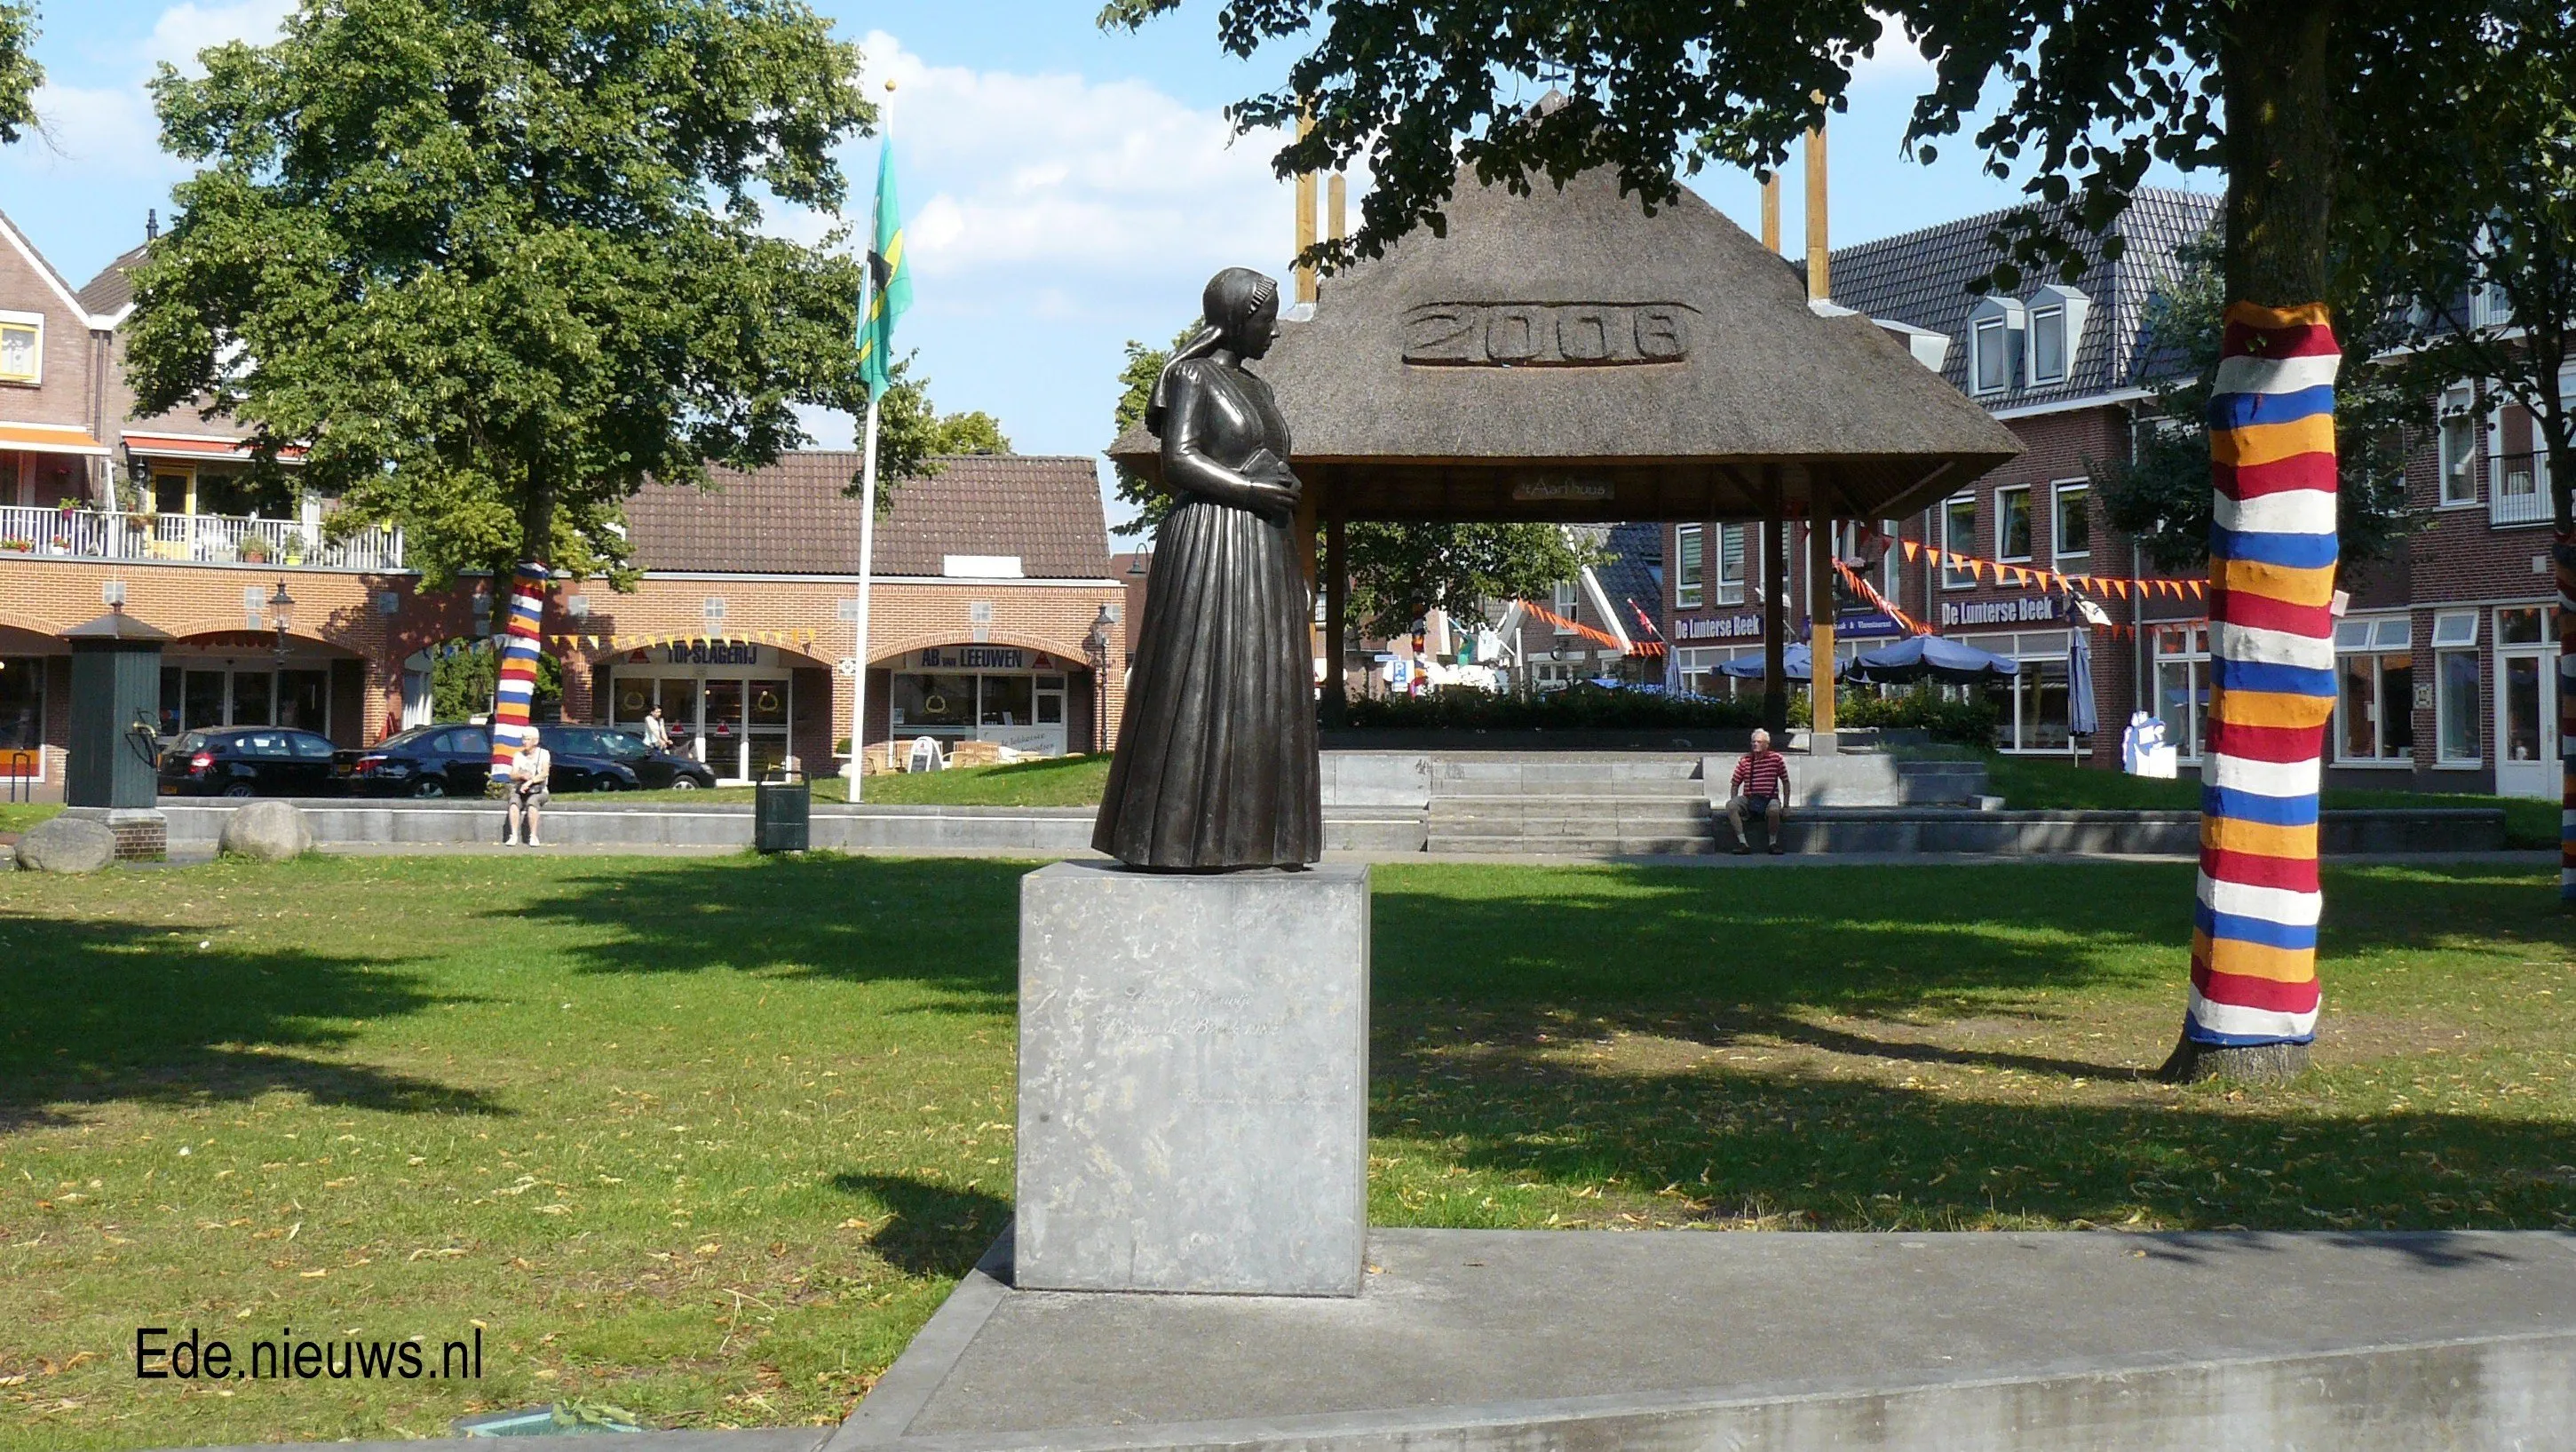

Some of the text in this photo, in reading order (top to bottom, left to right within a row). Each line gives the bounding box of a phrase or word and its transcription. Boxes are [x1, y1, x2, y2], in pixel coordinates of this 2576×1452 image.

[1942, 597, 2053, 625] De Lunterse Beek
[1676, 615, 1760, 639] De Lunterse Beek
[922, 648, 939, 666] AB
[960, 649, 1022, 668] LEEUWEN
[1395, 663, 1404, 675] P
